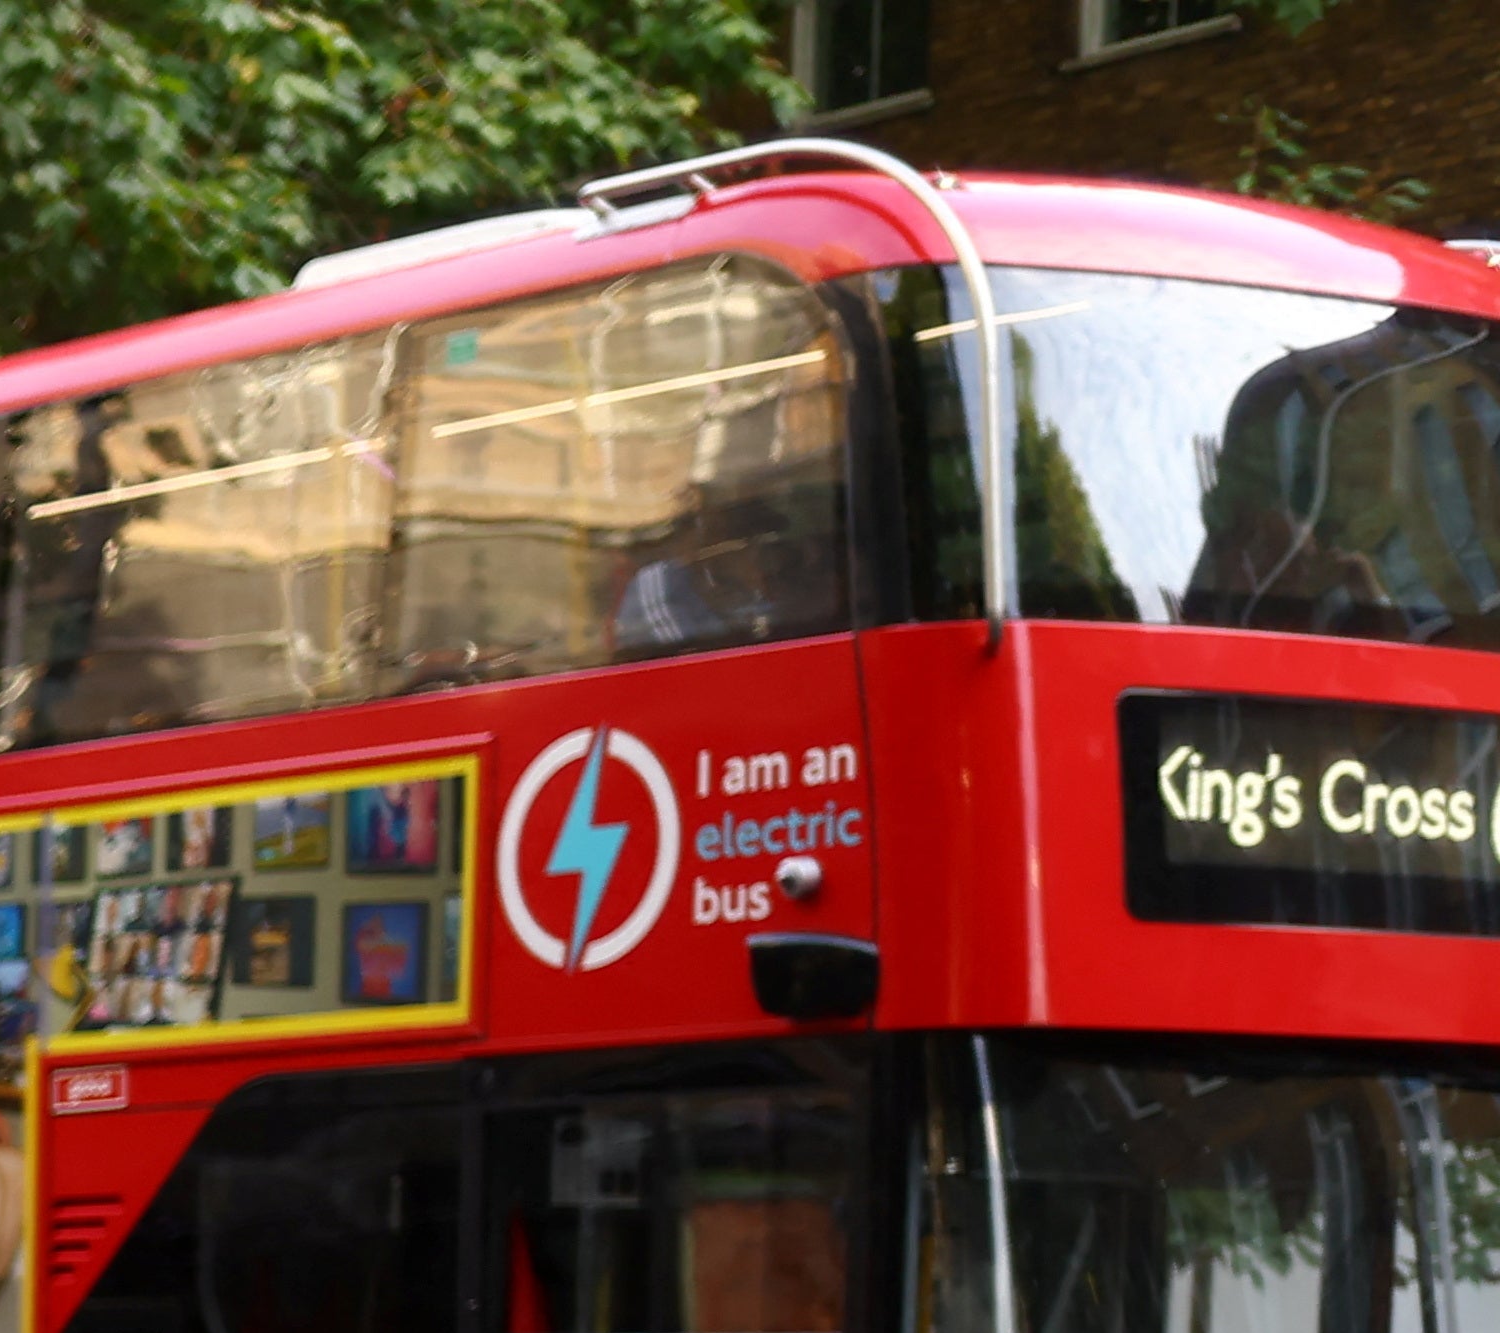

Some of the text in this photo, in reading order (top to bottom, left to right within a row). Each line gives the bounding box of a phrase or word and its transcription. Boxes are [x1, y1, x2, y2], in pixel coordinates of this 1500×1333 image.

[697, 743, 857, 798] I am an
[1319, 759, 1476, 843] Cross
[696, 801, 862, 861] electric
[692, 876, 771, 926] bus
